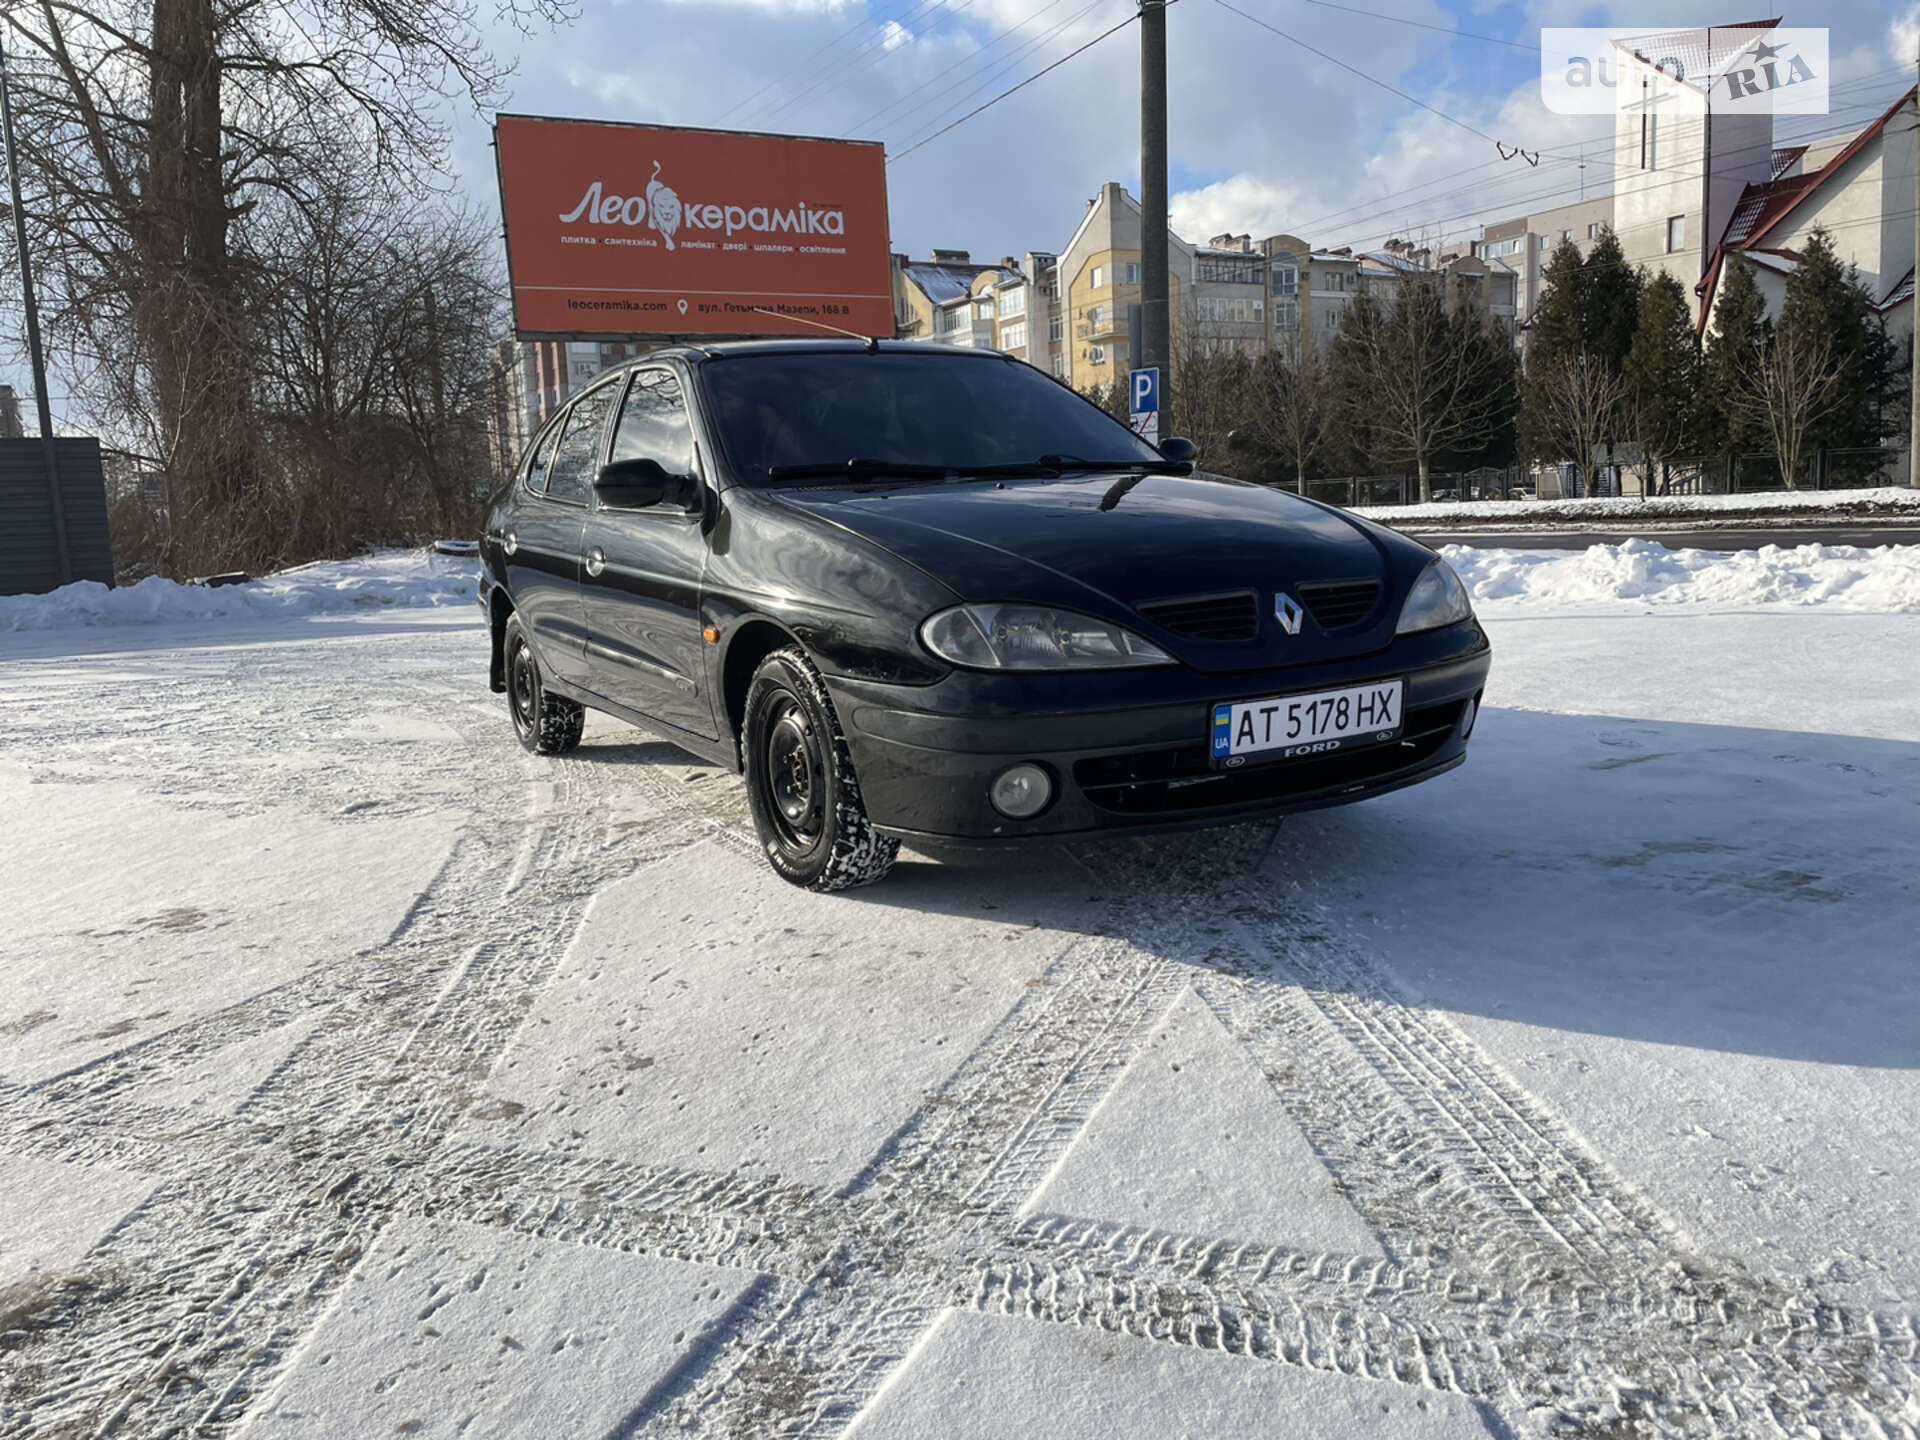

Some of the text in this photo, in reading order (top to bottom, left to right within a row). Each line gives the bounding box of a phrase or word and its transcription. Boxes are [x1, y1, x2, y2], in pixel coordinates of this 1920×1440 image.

[559, 181, 845, 237] Лео кераміка
[561, 235, 847, 255] плитка сантехніка ламінат двері шпалери освітлення
[567, 299, 668, 312] leoceramika.com
[698, 303, 721, 313] вул.
[1135, 374, 1152, 409] P
[1236, 688, 1394, 747] AT 5178 HX
[1214, 737, 1229, 749] UA
[1284, 740, 1341, 758] FORD
